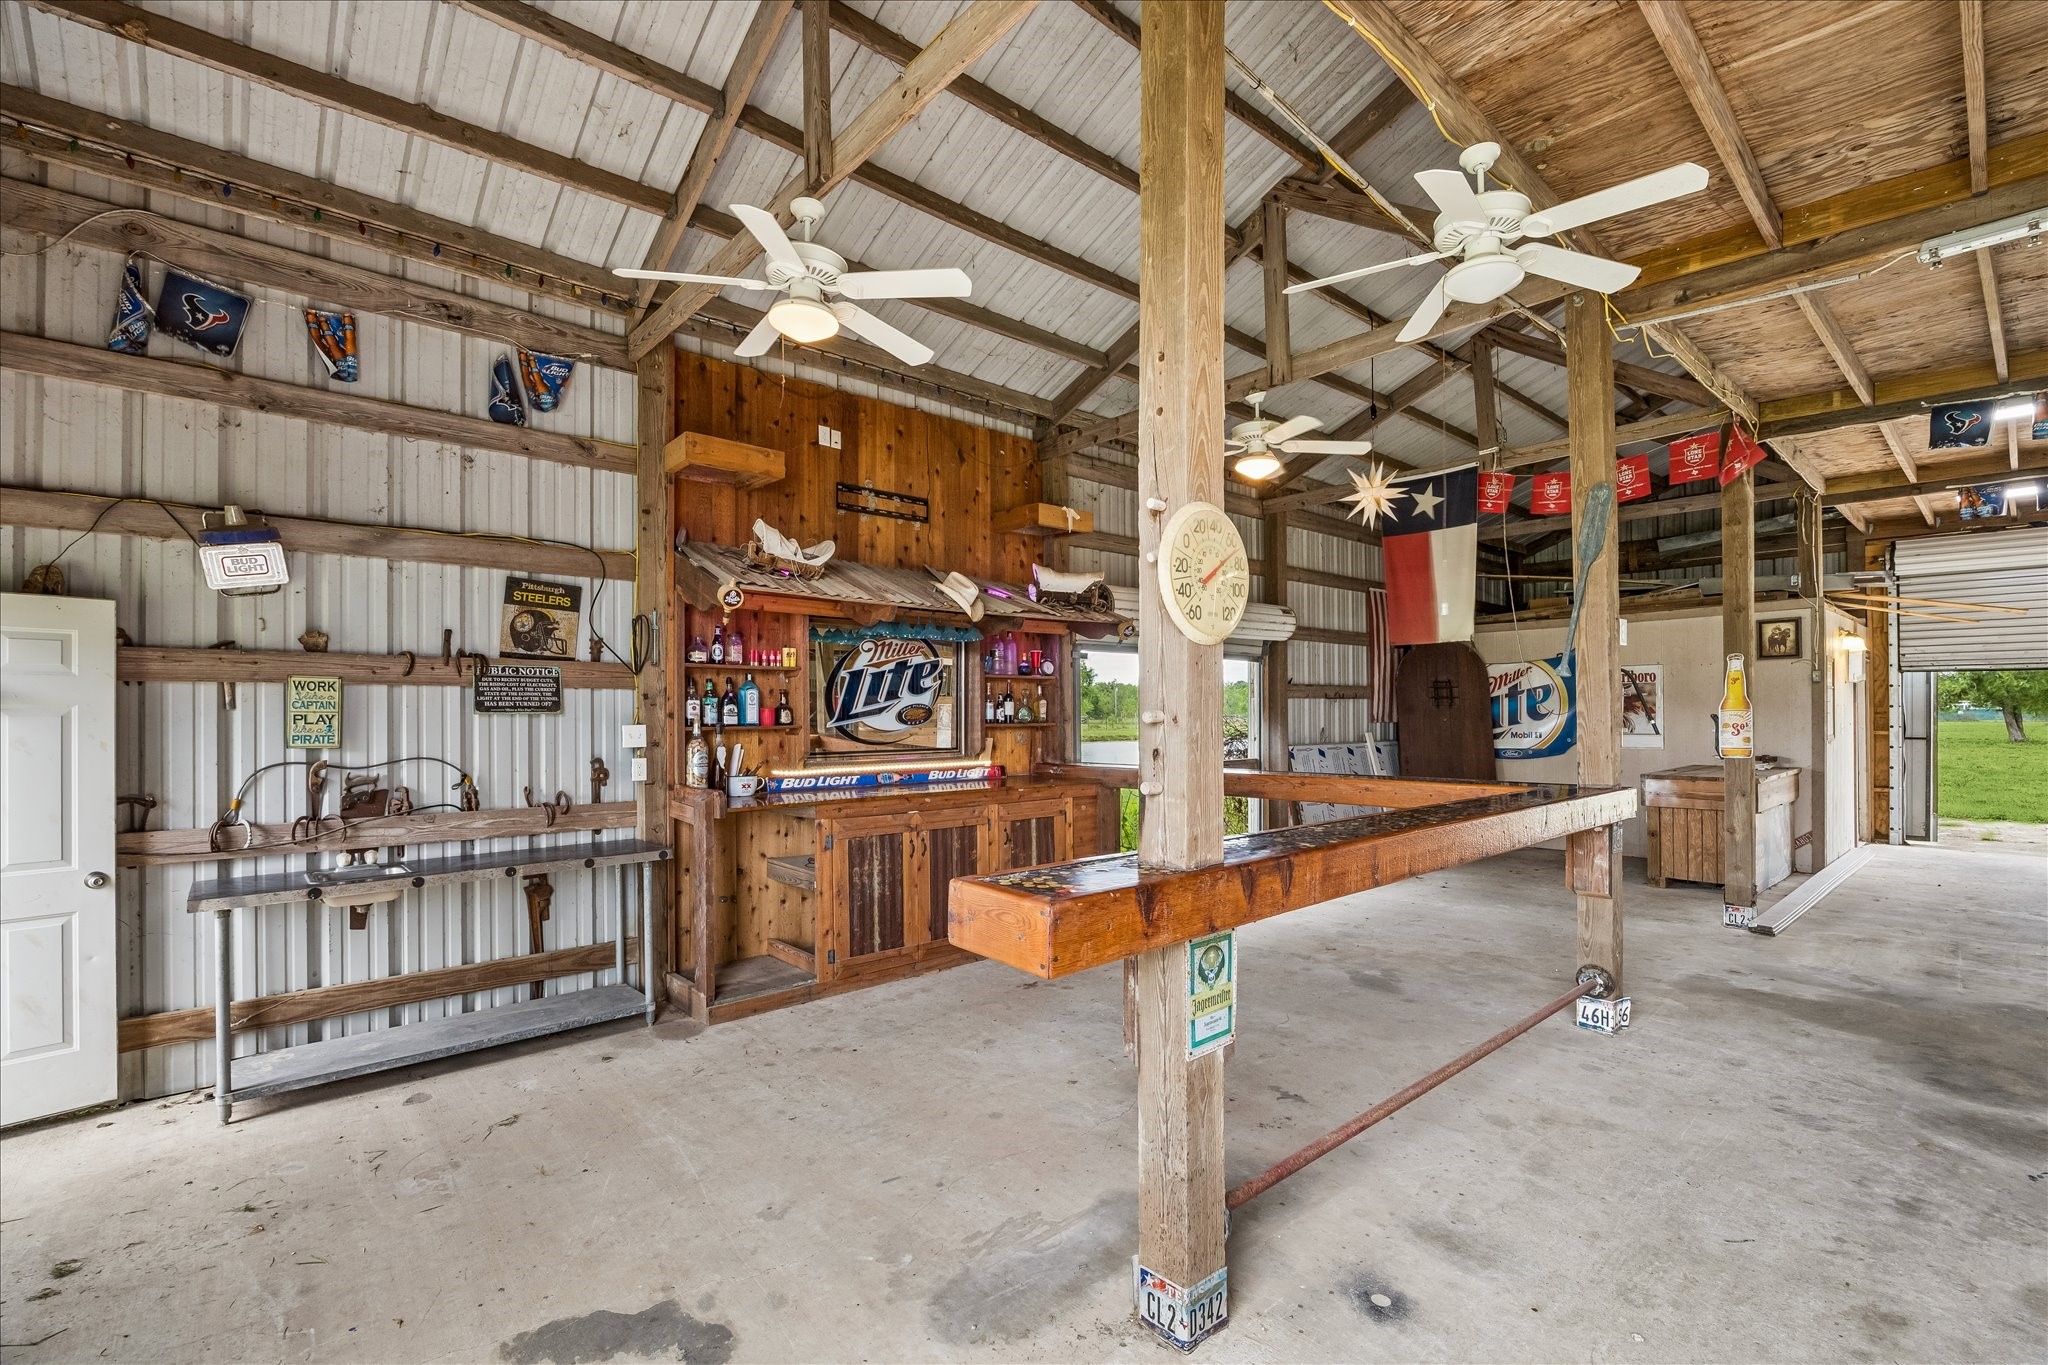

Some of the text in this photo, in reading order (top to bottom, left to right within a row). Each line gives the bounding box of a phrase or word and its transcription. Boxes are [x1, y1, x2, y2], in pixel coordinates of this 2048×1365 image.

[1687, 453, 1702, 461] STAR
[1194, 519, 1206, 534] 20
[1210, 520, 1222, 534] 40
[1183, 533, 1190, 548] 0
[230, 557, 258, 566] BUD
[1235, 556, 1246, 571] 80
[226, 564, 265, 573] LIGHT
[521, 582, 565, 594] Pittsburgh
[1232, 583, 1246, 598] 100
[513, 591, 571, 607] STEELERS
[859, 639, 926, 666] Miller
[519, 668, 559, 676] NOTICE
[293, 681, 336, 692] WORK
[1489, 666, 1532, 694] Miller
[826, 657, 943, 728] Lite
[292, 701, 336, 709] CAPTAIN
[293, 714, 336, 725] PLAY
[291, 735, 336, 745] PIRATE
[1510, 731, 1533, 739] Mobil
[928, 768, 990, 780] BUD LIGHT
[781, 776, 860, 789] BUD LIGHT
[1581, 1005, 1610, 1028] 46H
[1189, 1291, 1223, 1339] D342
